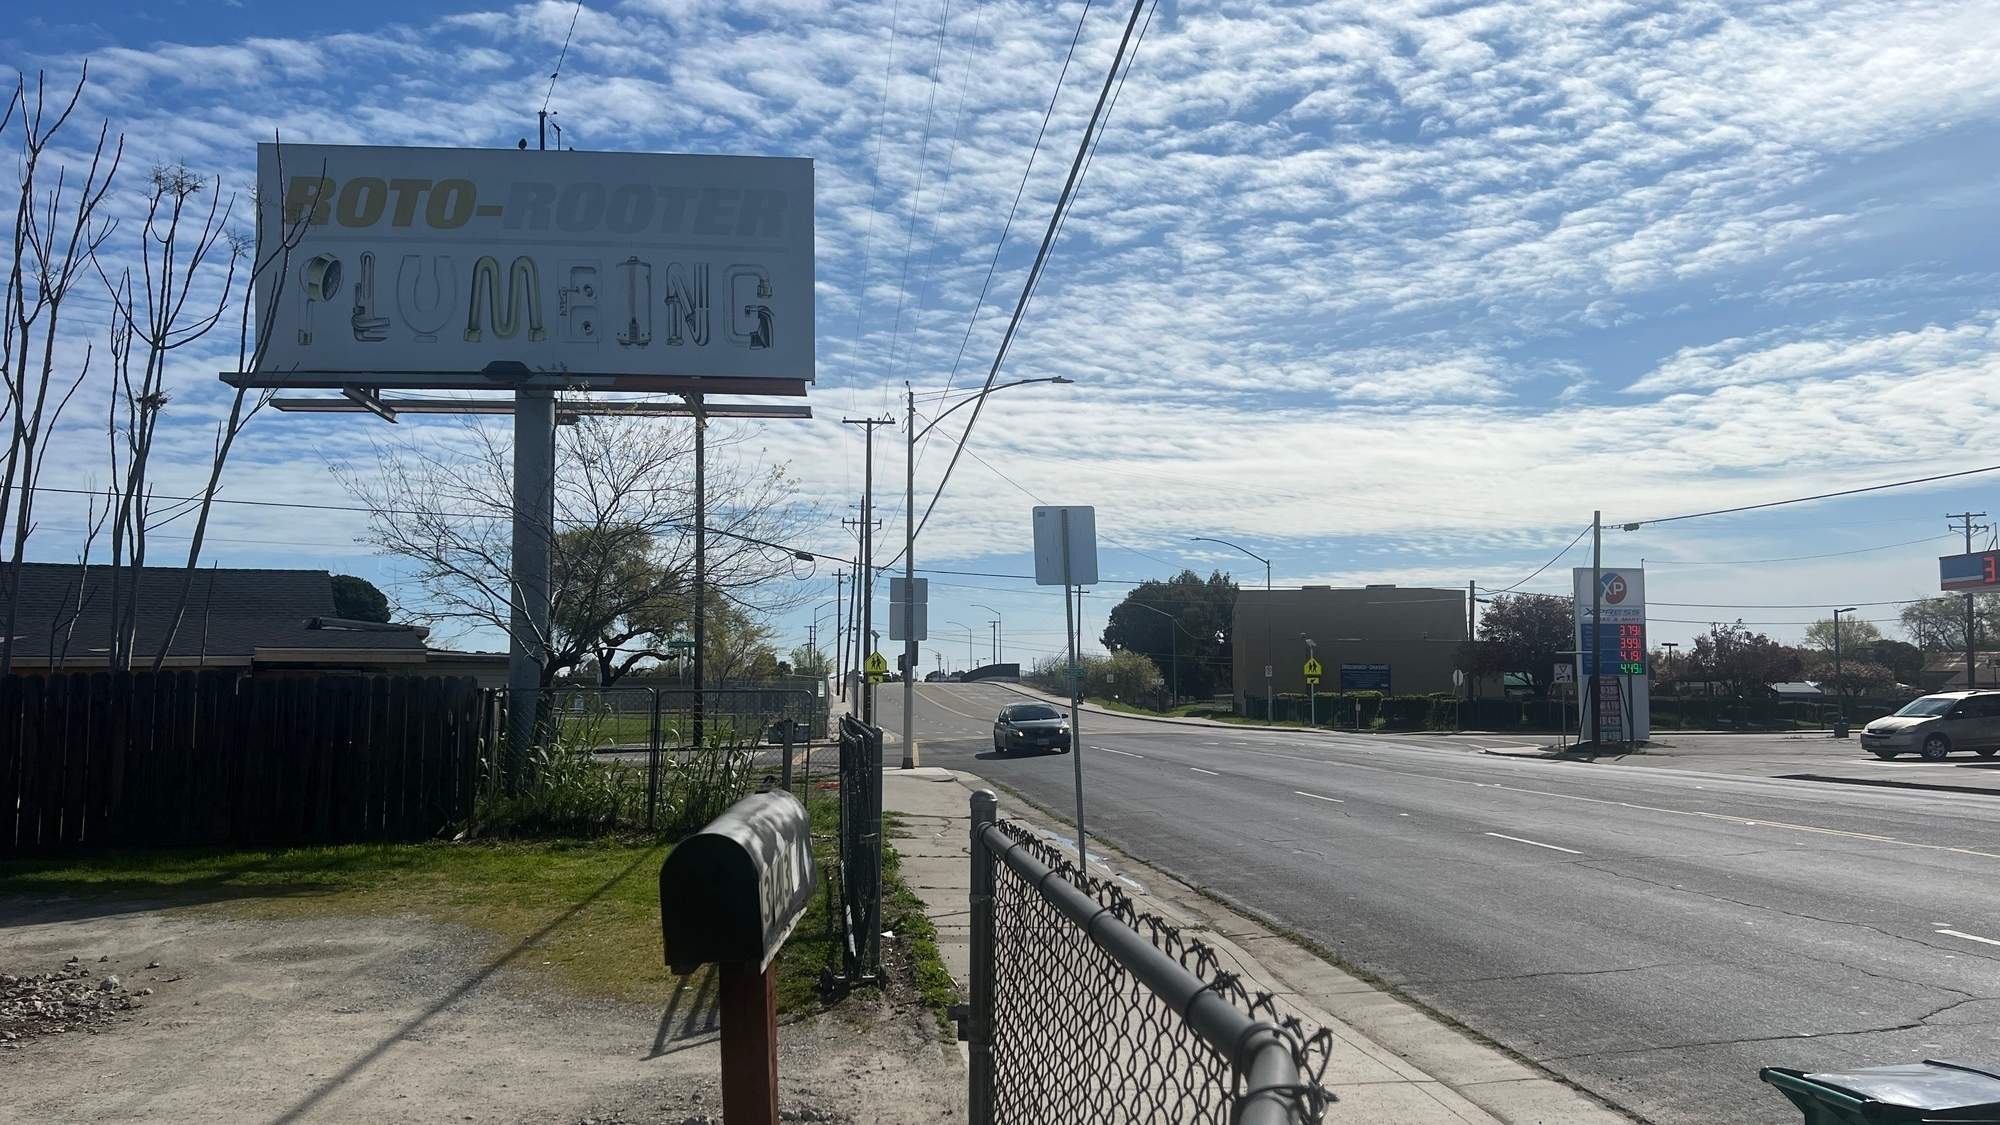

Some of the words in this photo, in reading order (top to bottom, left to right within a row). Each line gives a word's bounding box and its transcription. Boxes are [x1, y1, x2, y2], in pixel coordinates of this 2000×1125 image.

[285, 176, 789, 238] ROTO-ROOTER
[297, 250, 776, 350] PLUMBING
[1601, 575, 1624, 596] XP
